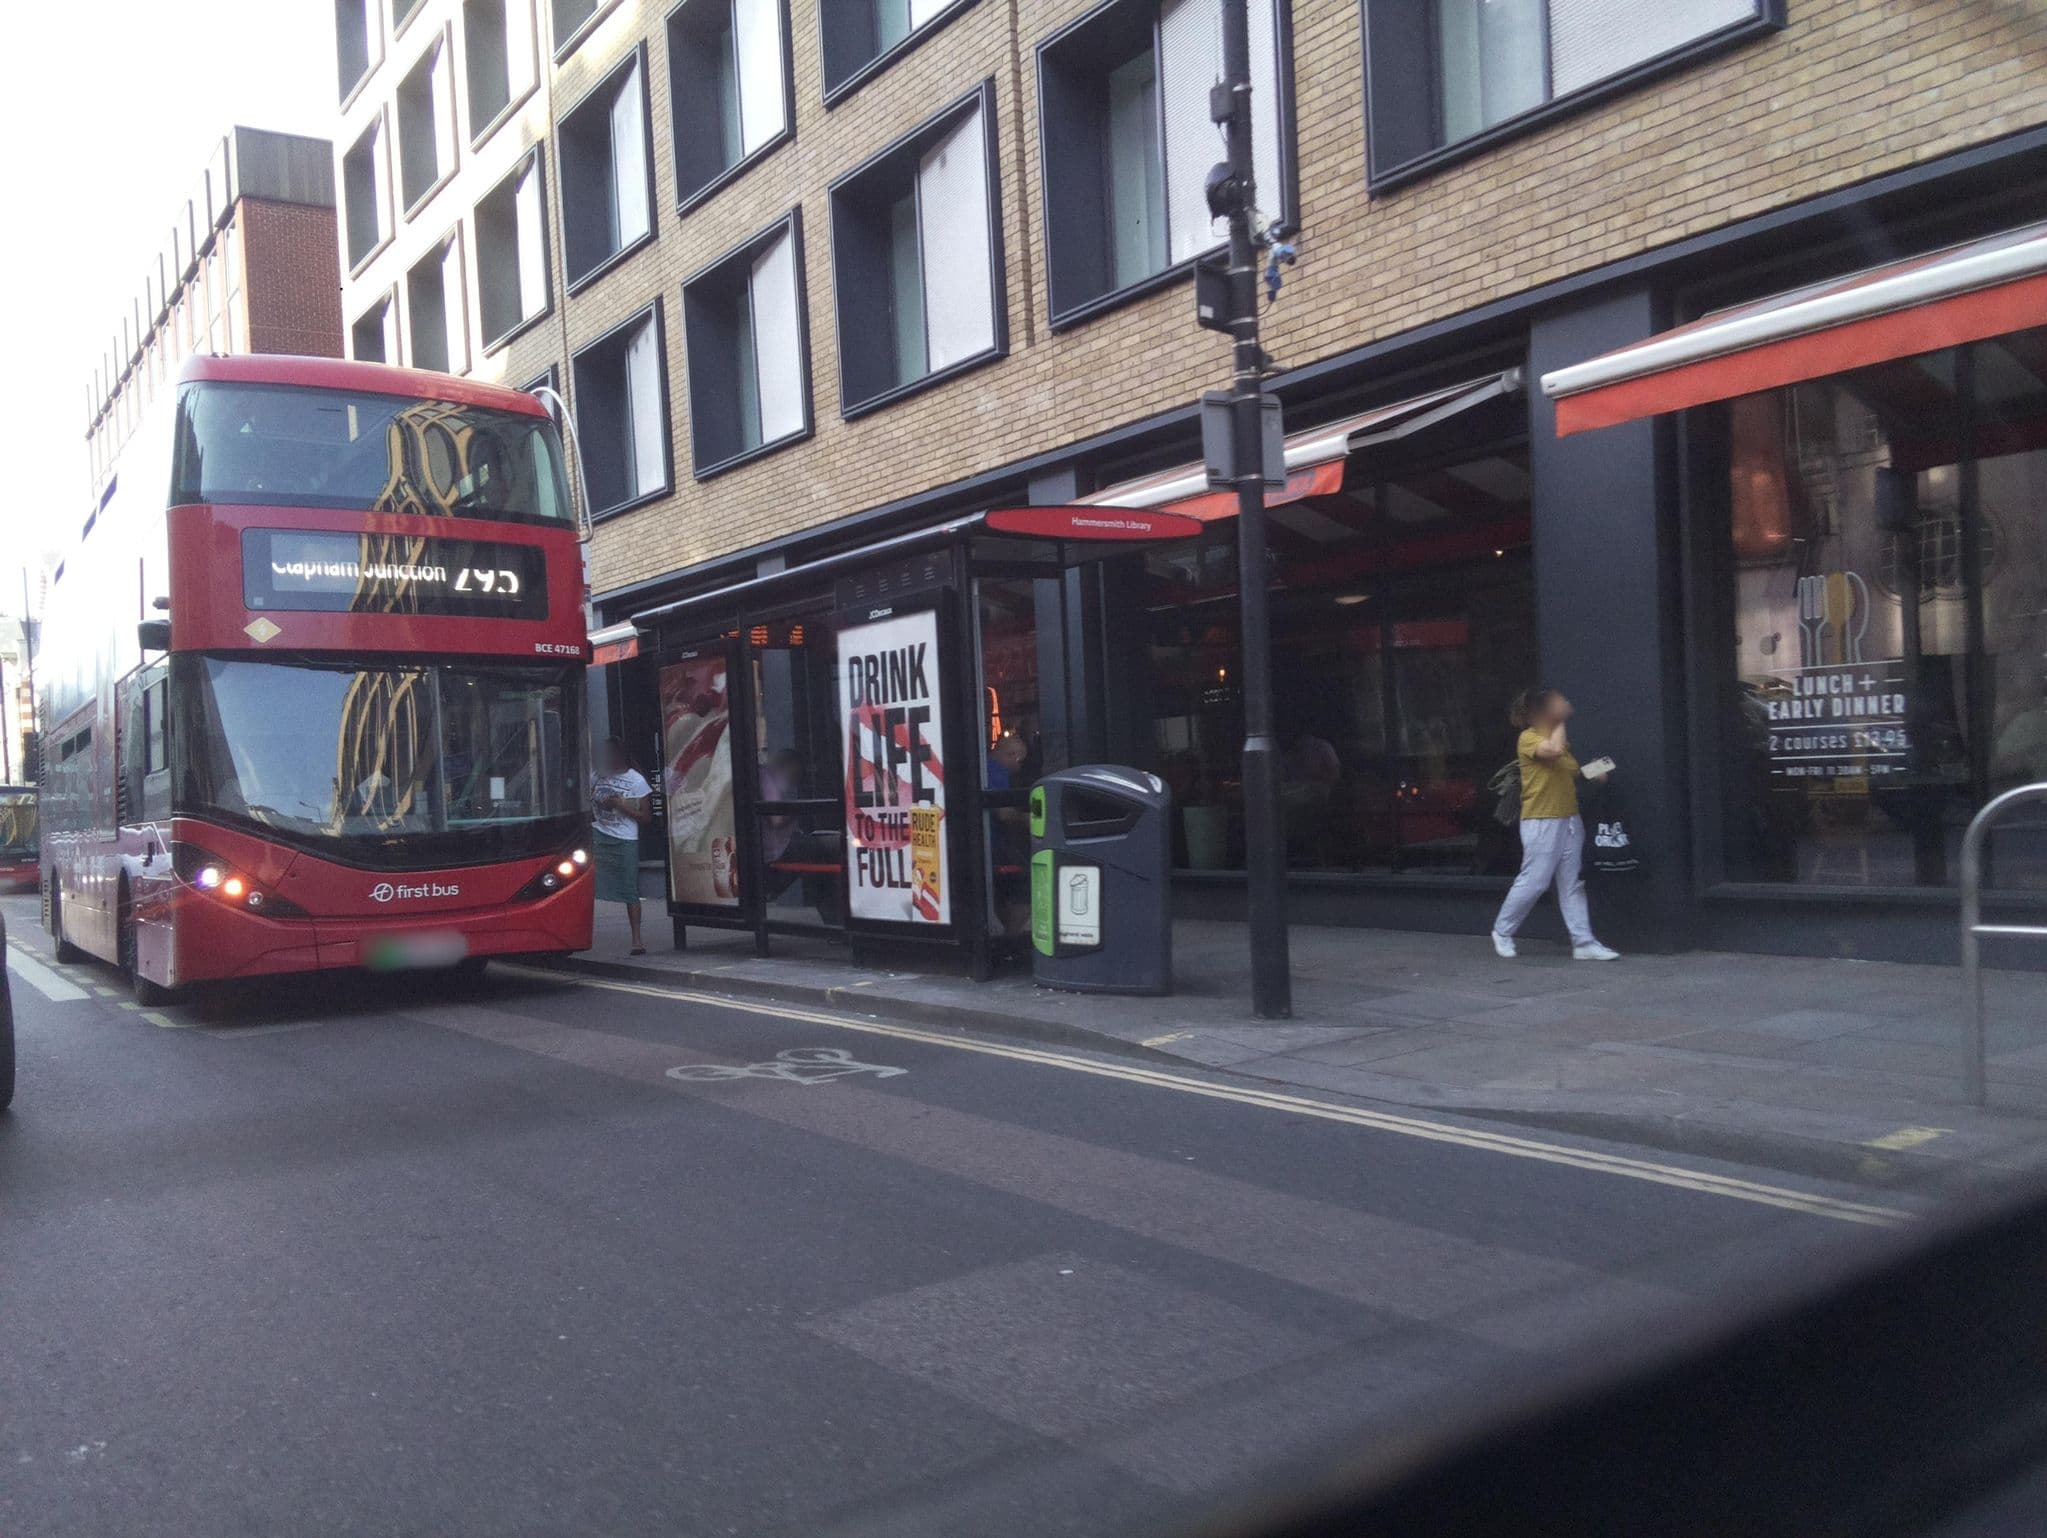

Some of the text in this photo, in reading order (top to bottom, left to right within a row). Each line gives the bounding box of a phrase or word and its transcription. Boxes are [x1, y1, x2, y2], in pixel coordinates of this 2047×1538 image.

[1071, 517, 1152, 532] Hammersmith Library
[535, 643, 553, 653] BCE
[848, 642, 930, 709] DRINK
[1792, 674, 1854, 697] LUNCH
[1767, 693, 1906, 721] EARLY DINNER
[1768, 735, 1778, 751] 2
[1783, 734, 1848, 750] courses
[850, 705, 935, 808] LIFE
[854, 812, 911, 842] TO THE
[912, 812, 936, 833] RUDE
[913, 832, 937, 848] HEALTH
[856, 846, 913, 889] FULL
[396, 882, 459, 899] first bus
